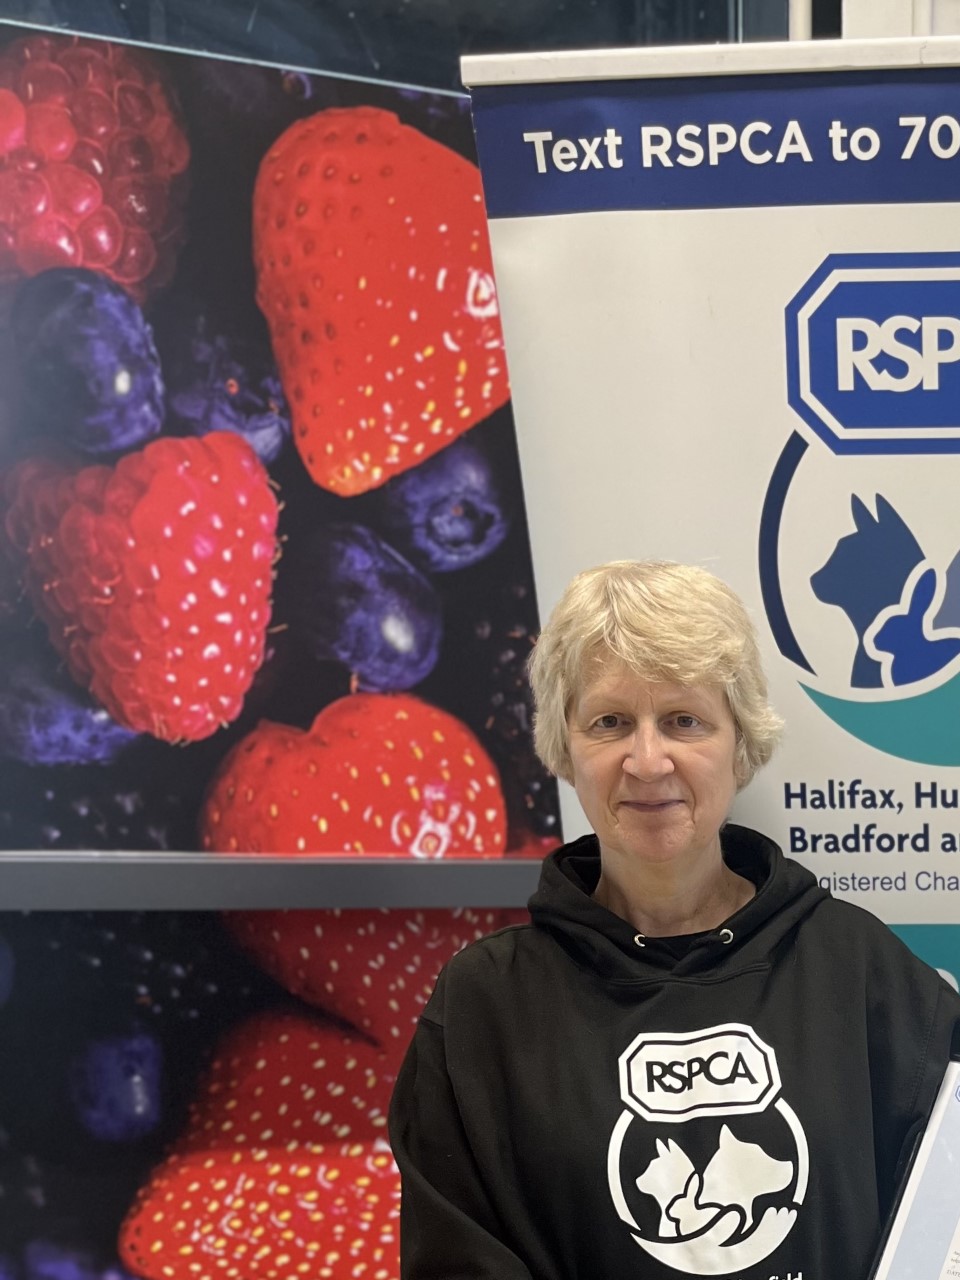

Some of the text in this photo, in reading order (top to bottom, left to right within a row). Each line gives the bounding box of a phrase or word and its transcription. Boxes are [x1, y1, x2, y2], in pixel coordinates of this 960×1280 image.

[523, 130, 622, 175] Text
[640, 120, 812, 169] RSPCA
[828, 119, 877, 163] to
[783, 781, 905, 815] Halifax,
[788, 825, 930, 855] Bradford
[819, 871, 907, 894] gistered
[645, 1051, 759, 1093] RSPCA
